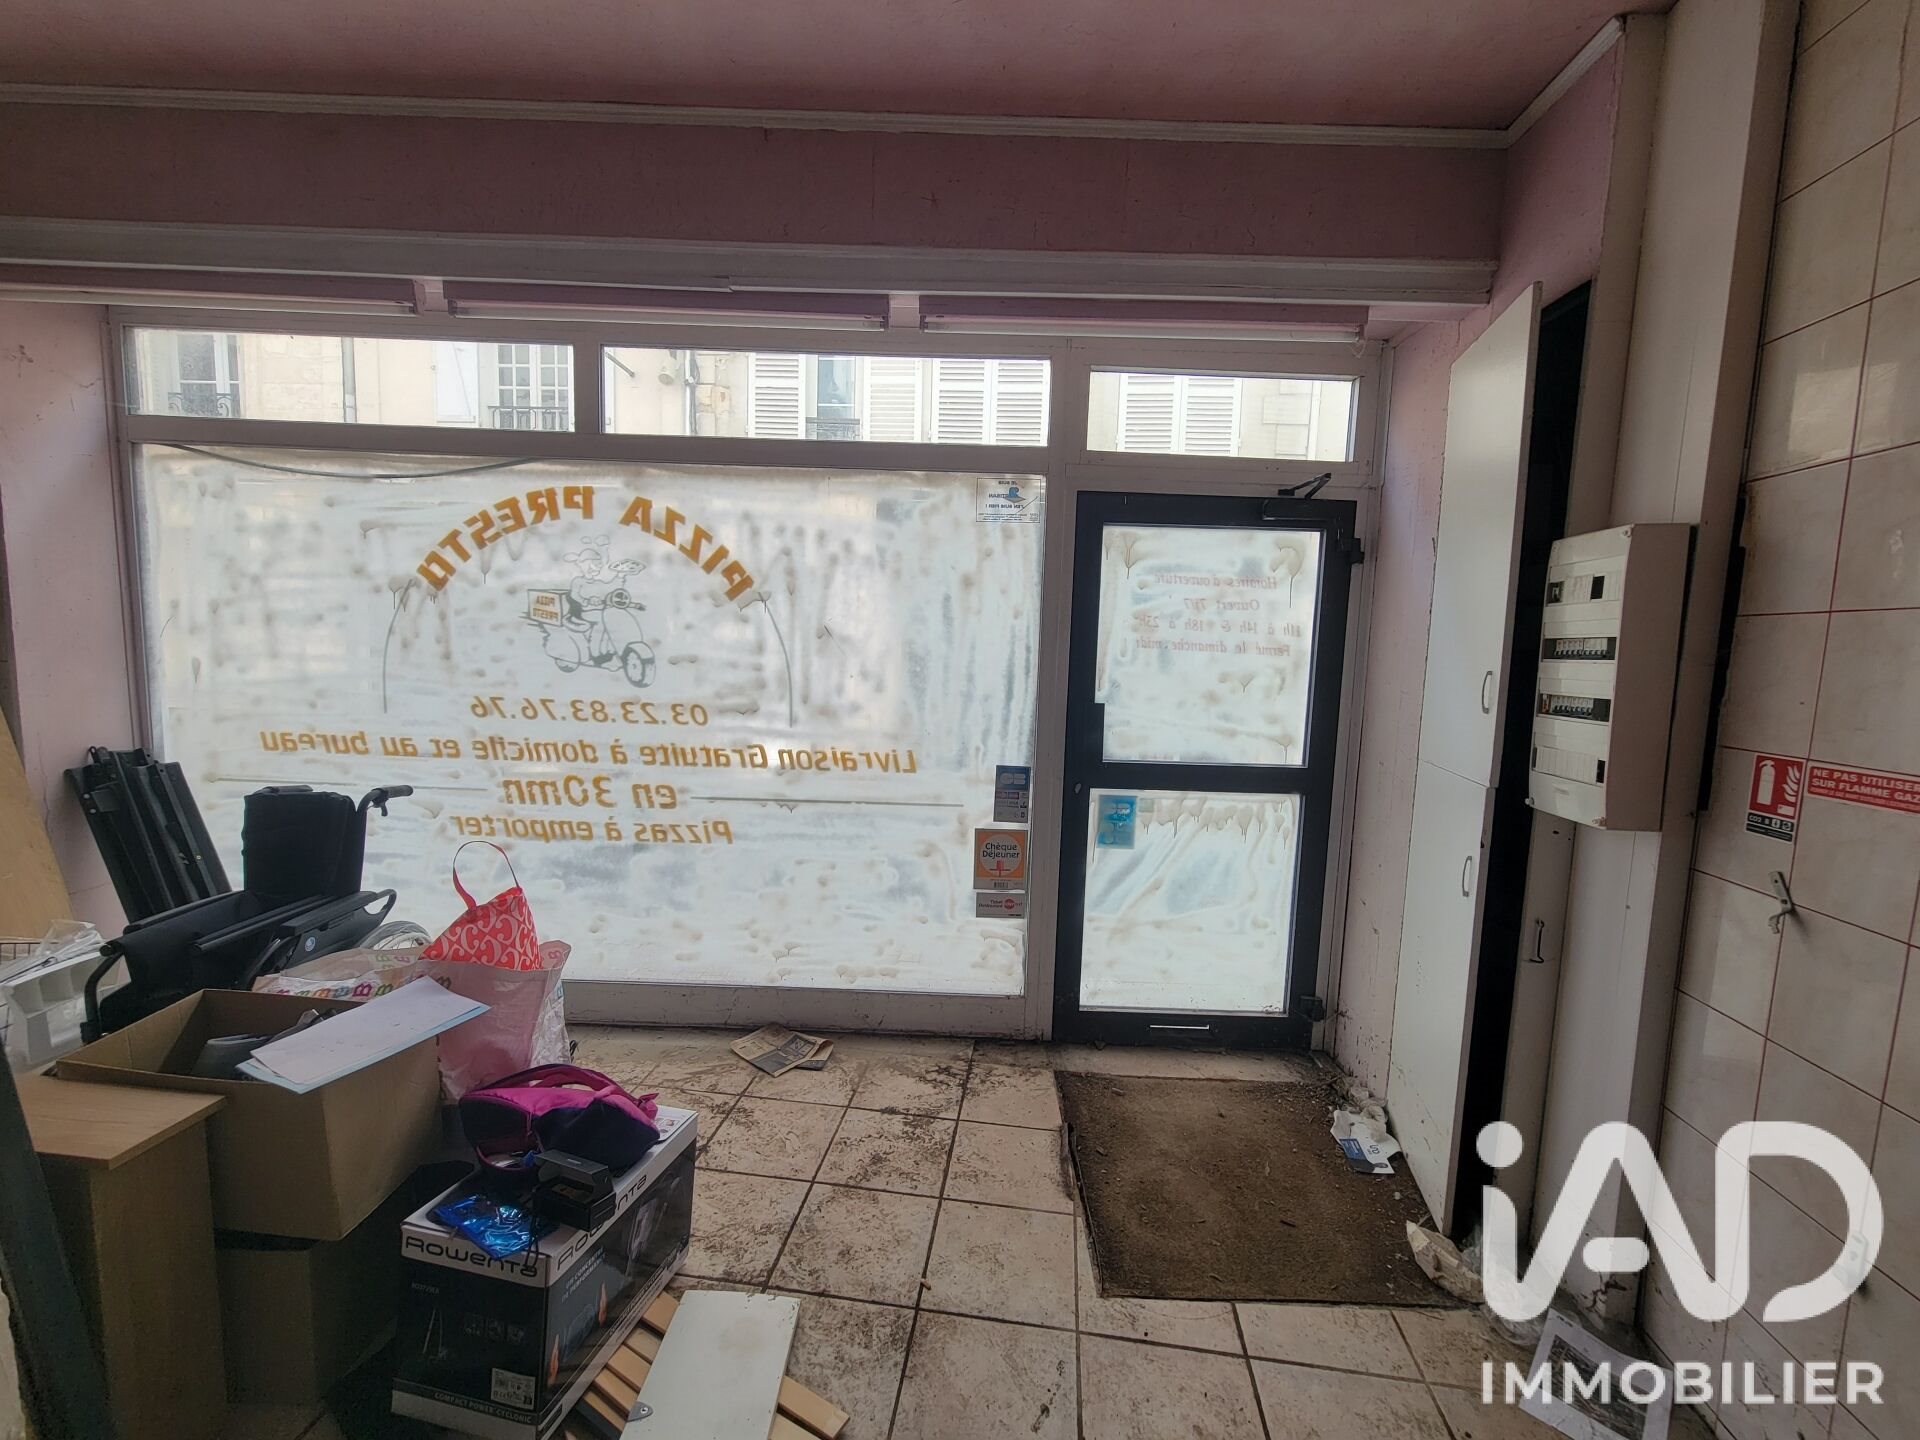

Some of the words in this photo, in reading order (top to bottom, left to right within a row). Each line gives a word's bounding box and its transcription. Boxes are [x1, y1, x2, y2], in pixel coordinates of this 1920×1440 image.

[1812, 768, 1830, 779] NE
[1833, 771, 1858, 783] PAS
[1862, 775, 1920, 793] UTILISER
[1811, 778, 1836, 789] SUR
[1838, 782, 1891, 799] FLAMME
[1893, 791, 1920, 804] GAZ
[982, 849, 1020, 860] Déjeuner
[985, 842, 1018, 852] Chèque
[496, 1407, 533, 1424] CYCLONIC
